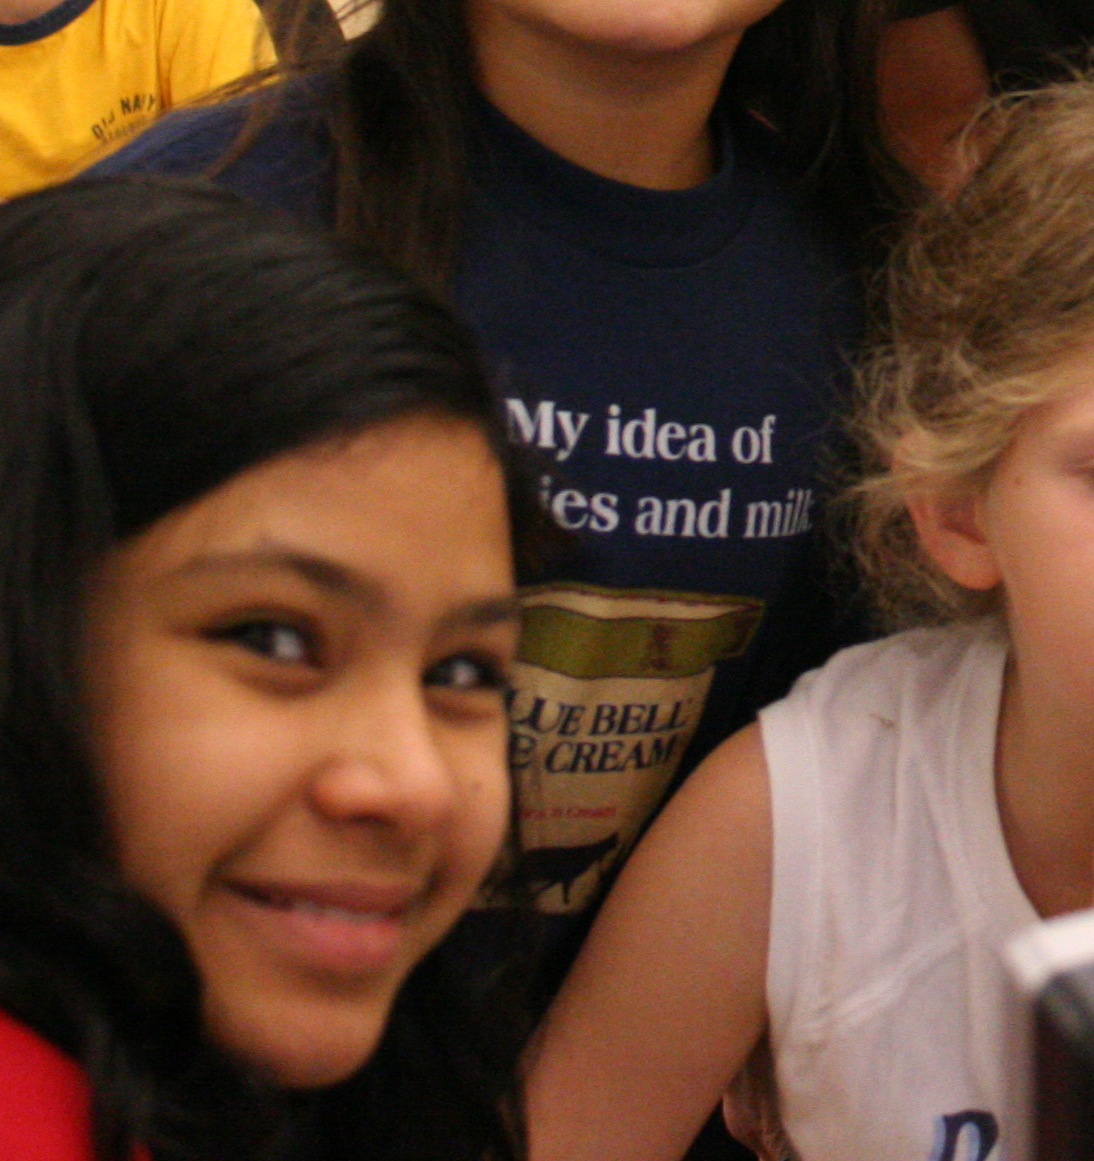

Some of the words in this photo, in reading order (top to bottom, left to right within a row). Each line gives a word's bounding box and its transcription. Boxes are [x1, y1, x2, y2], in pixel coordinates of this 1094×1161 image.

[504, 397, 591, 463] My
[604, 403, 717, 463] idea
[731, 413, 777, 465] of
[634, 487, 732, 539] and
[588, 700, 688, 736] BELL
[544, 734, 679, 775] CREAM
